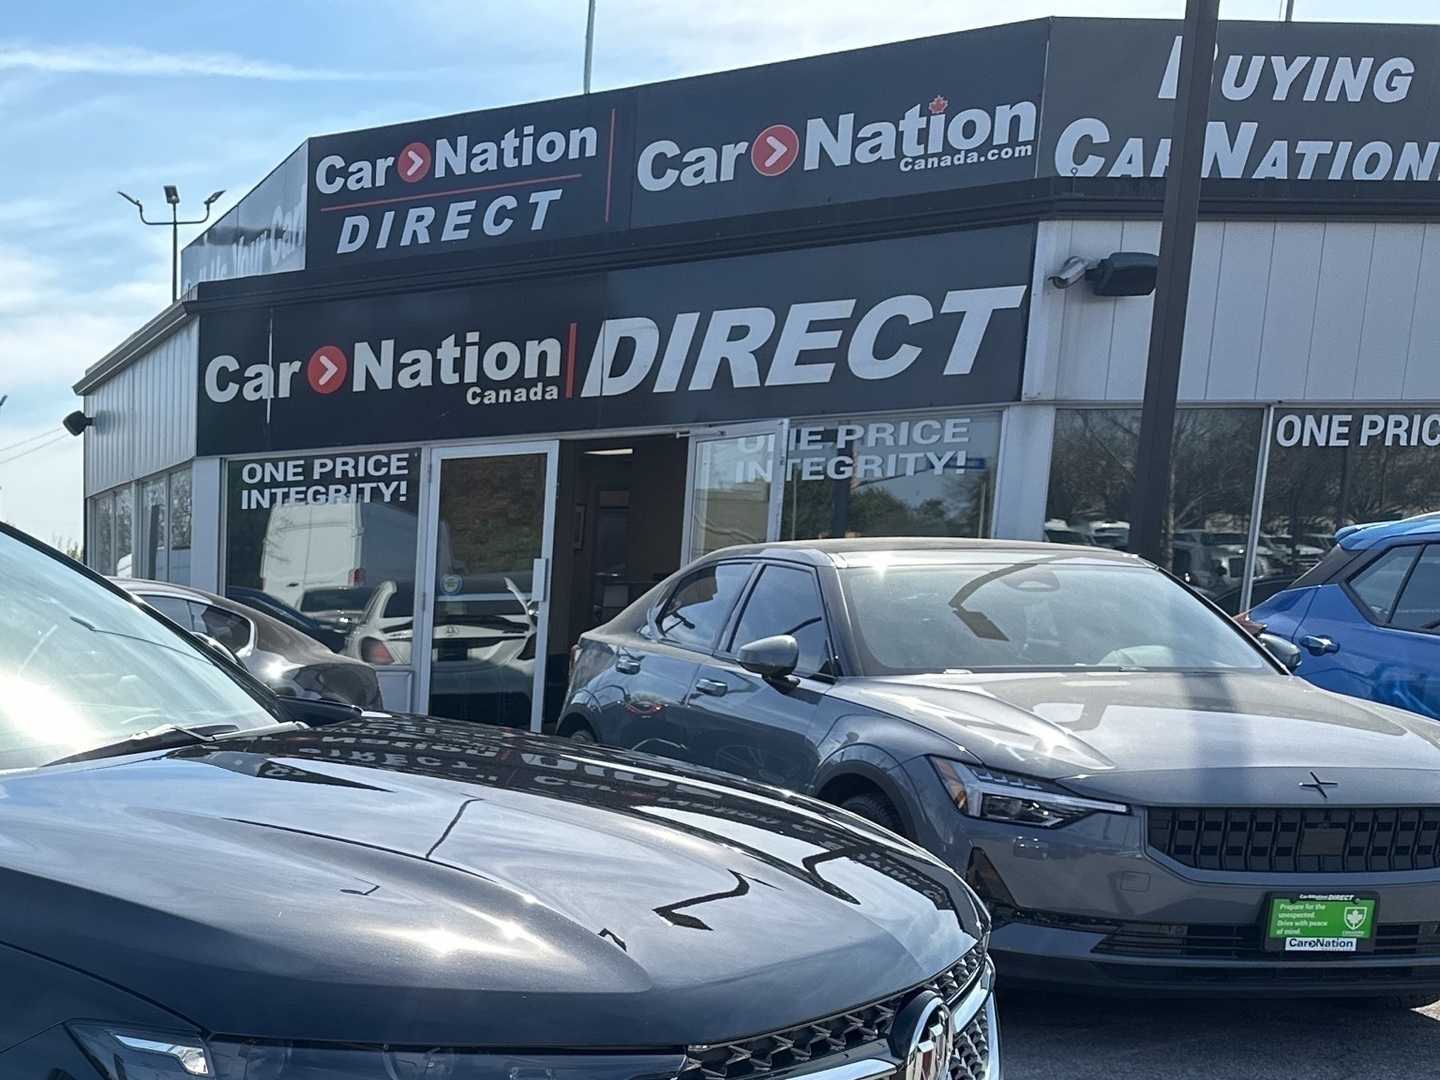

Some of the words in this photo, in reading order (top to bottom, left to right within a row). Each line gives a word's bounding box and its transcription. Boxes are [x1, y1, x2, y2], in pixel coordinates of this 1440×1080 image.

[316, 155, 395, 194] Car
[434, 125, 597, 178] Nation
[637, 140, 748, 192] Car
[803, 101, 1037, 171] Nation
[899, 144, 1032, 172] Canada.com
[336, 189, 562, 254] DIRECT
[205, 355, 302, 403] Car
[352, 332, 561, 392] Nation
[580, 285, 1027, 398] DIRECT
[466, 382, 558, 405] Canada
[837, 418, 971, 449] PRICE
[1276, 414, 1352, 447] ONE
[242, 460, 305, 484] ONE
[313, 453, 409, 480] PRICE
[241, 481, 407, 510] INTEGRITY!
